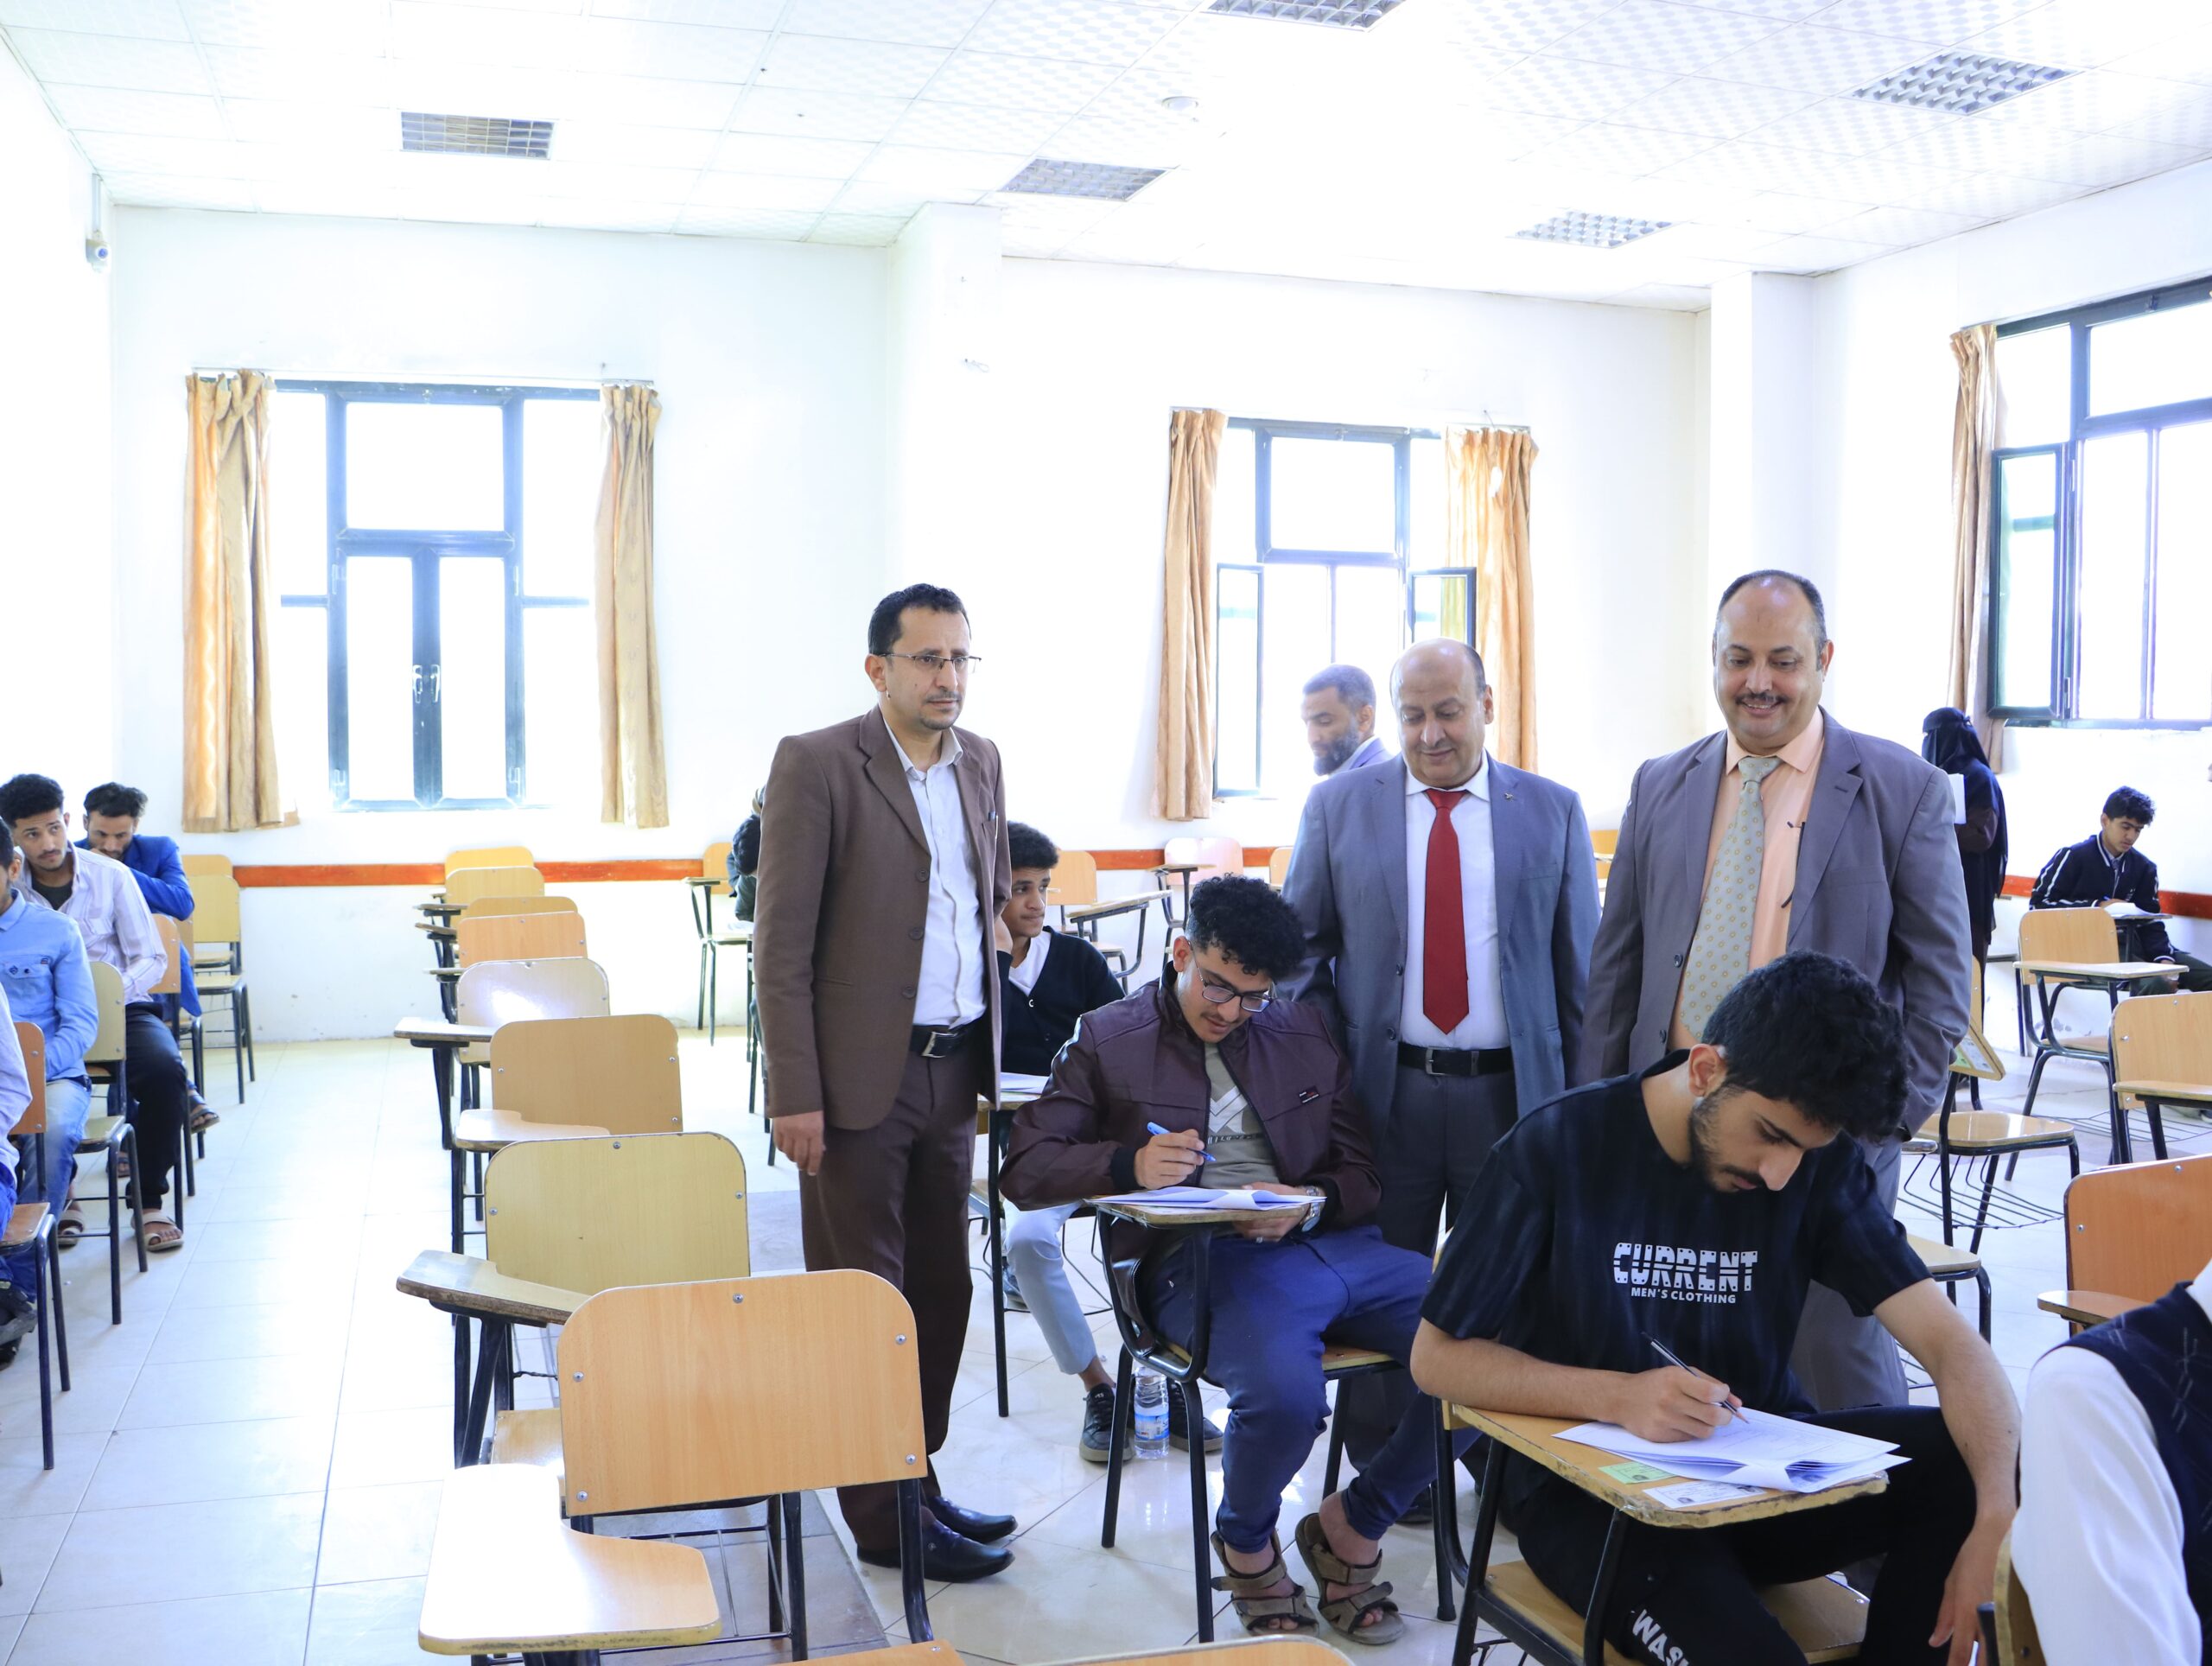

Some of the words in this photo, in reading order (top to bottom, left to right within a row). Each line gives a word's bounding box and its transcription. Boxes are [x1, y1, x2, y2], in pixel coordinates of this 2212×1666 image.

[1613, 1242, 1758, 1292] CURRENT
[1630, 1287, 1669, 1300] MEN'S
[1670, 1290, 1737, 1304] CLOTHING
[1632, 1609, 1689, 1666] WAS
